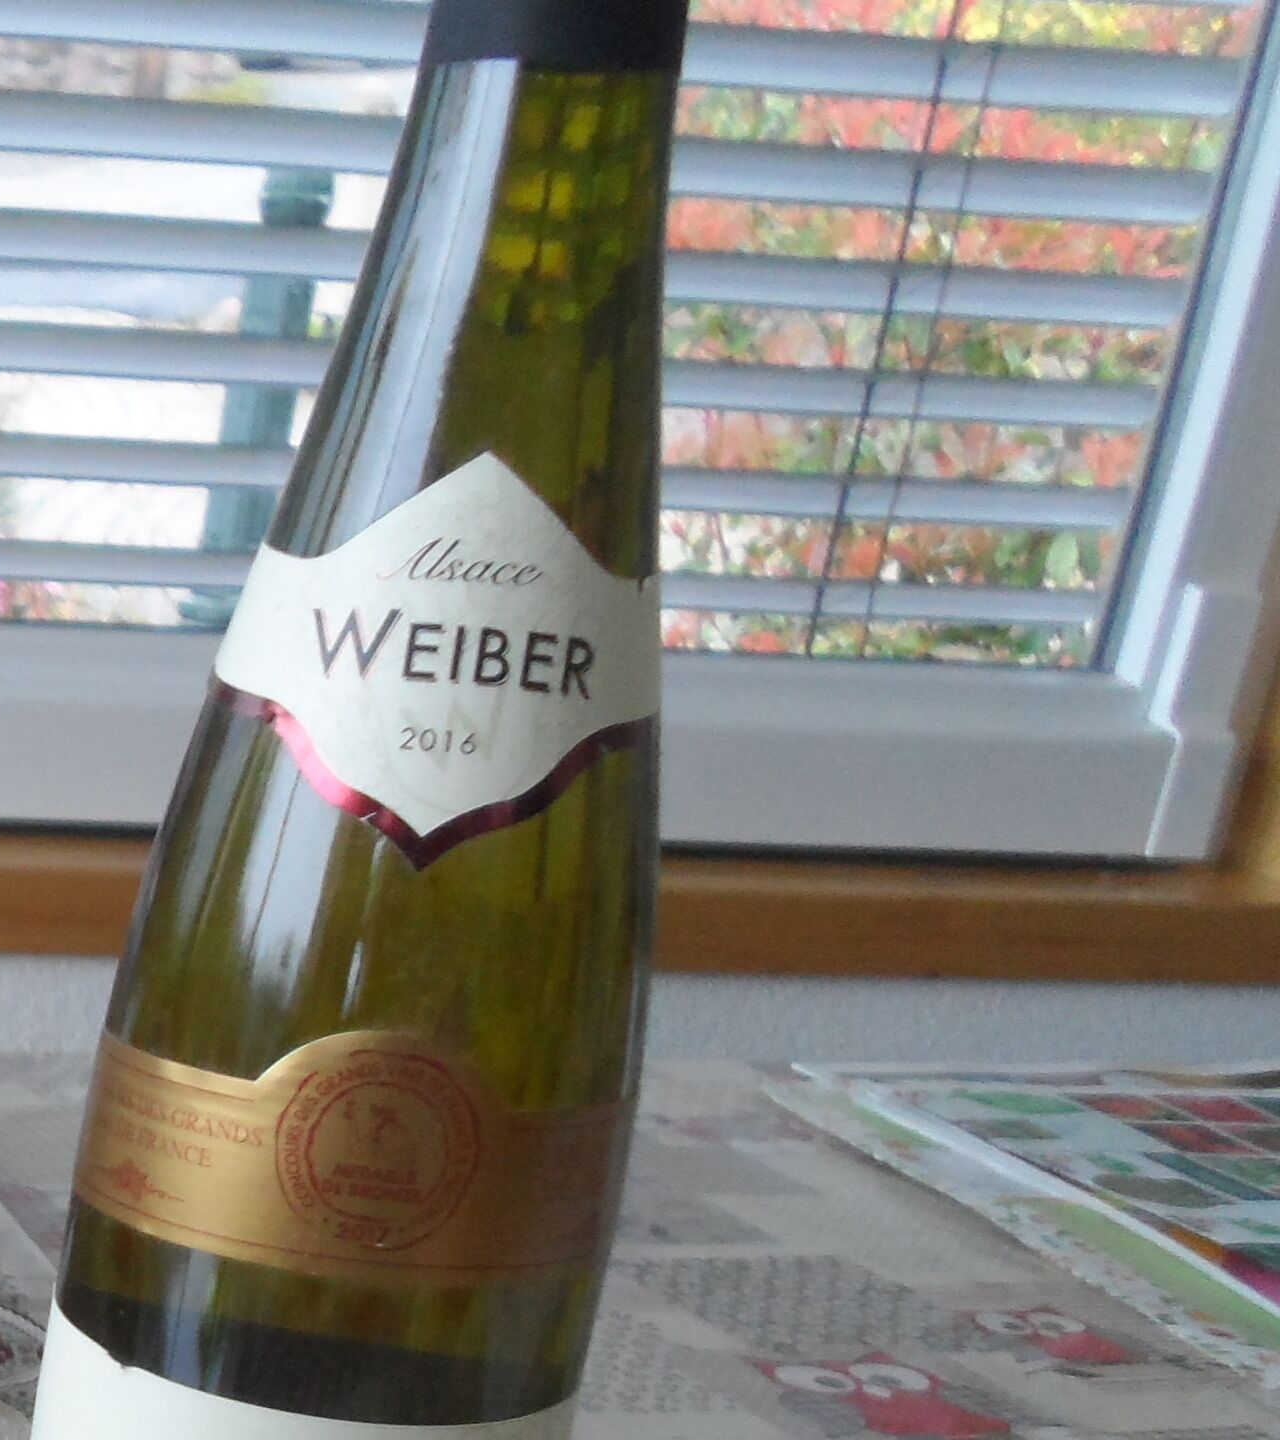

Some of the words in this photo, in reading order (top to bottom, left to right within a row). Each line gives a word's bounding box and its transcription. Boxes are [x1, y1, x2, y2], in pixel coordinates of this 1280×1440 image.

[377, 538, 545, 586] Alsace
[313, 607, 595, 700] WEIBER
[399, 726, 478, 756] 2016
[171, 1107, 264, 1148] GRANDS
